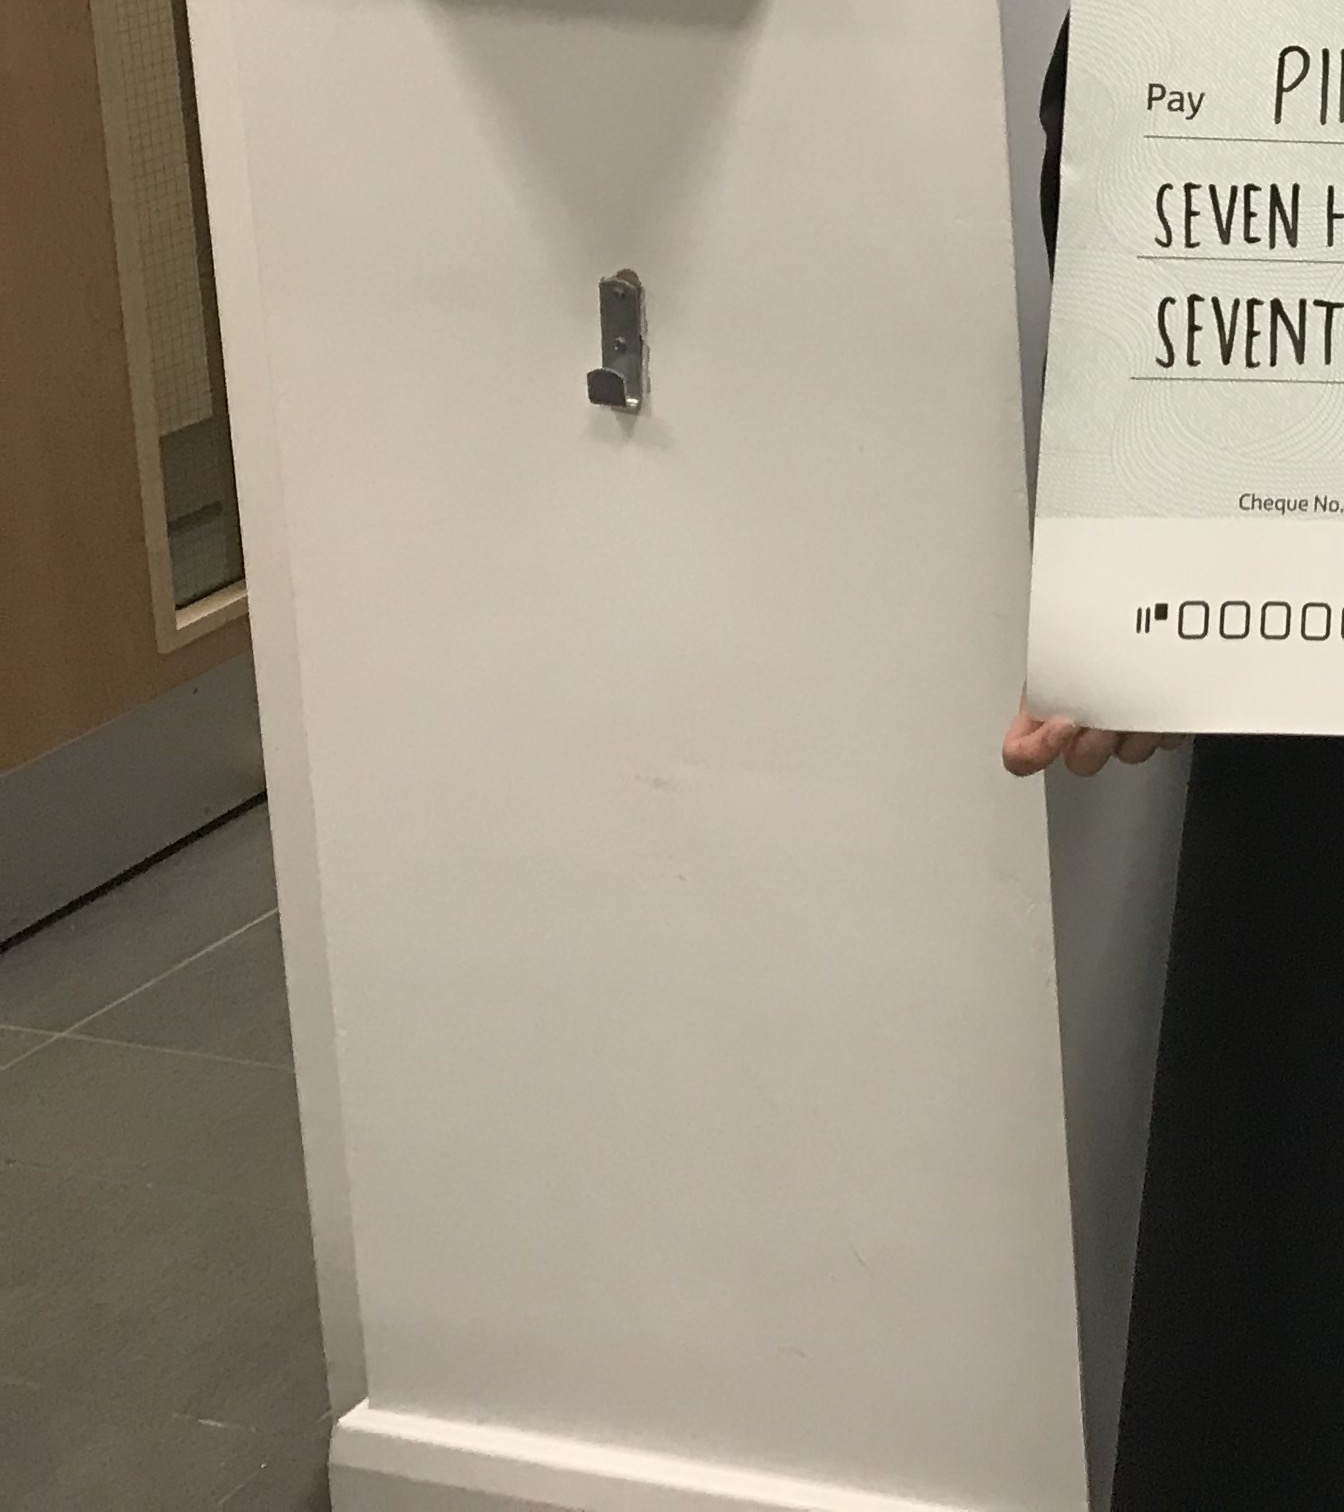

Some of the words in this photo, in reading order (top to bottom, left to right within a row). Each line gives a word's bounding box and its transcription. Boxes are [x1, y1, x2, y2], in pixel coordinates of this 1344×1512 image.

[1146, 83, 1206, 120] Pay
[1155, 182, 1301, 250] SEVEN
[1238, 492, 1310, 515] Cheque
